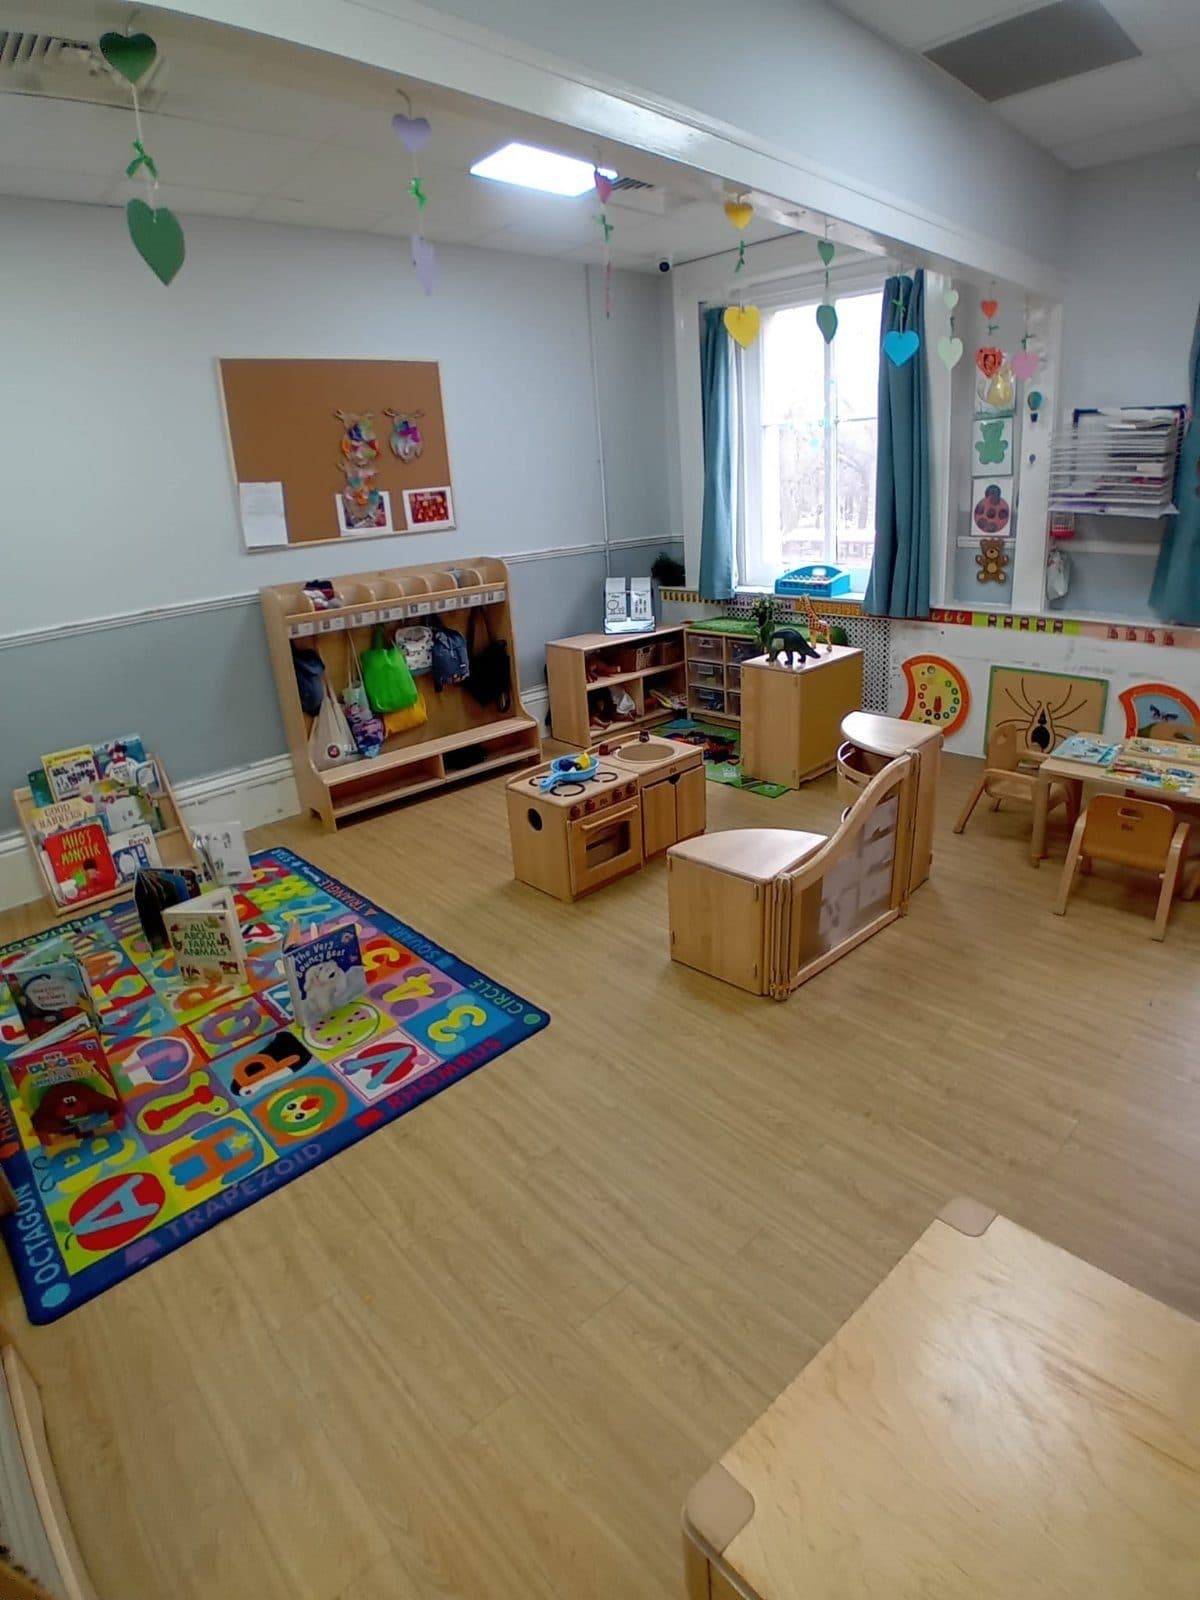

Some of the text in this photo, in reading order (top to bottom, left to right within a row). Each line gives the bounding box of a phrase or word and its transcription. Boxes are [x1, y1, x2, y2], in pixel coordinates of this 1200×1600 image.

[61, 843, 101, 866] MONSTER
[190, 924, 207, 932] ALL
[184, 932, 216, 940] ABOUT
[189, 940, 217, 948] FARM
[313, 940, 334, 953] Very
[184, 947, 229, 957] ANIMALS
[326, 948, 346, 960] Bear
[468, 978, 524, 1016] CIRCLE
[388, 1038, 502, 1111] RHOMBUS
[165, 1142, 323, 1240] TRAPEZOID
[14, 1181, 60, 1285] OCTAGON
